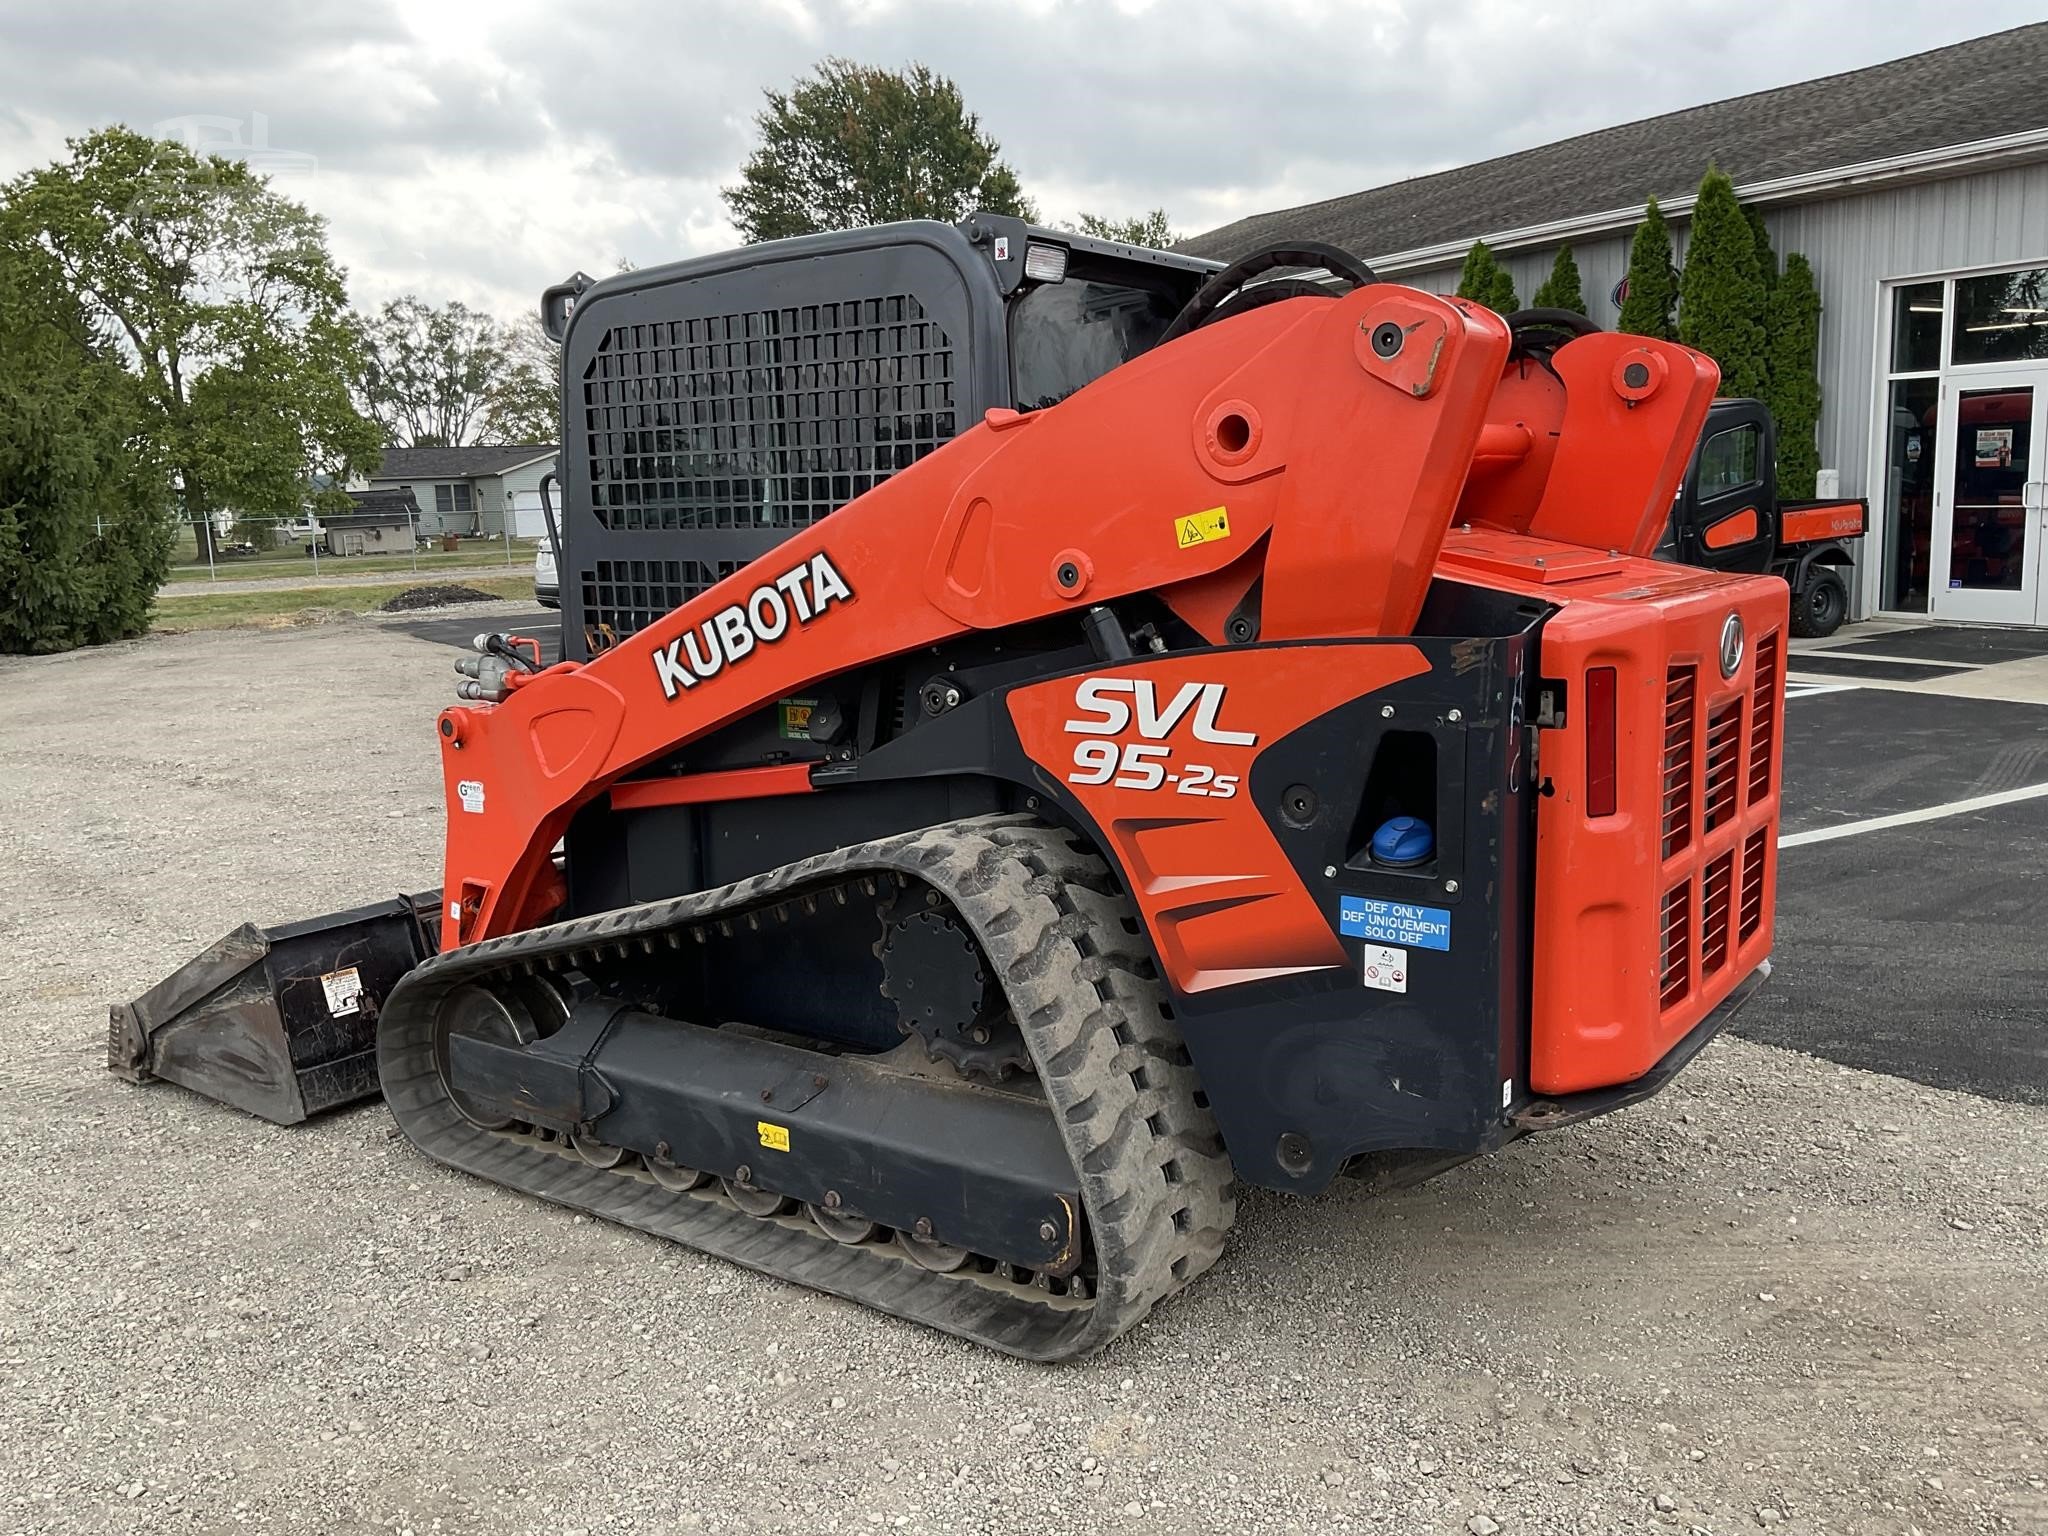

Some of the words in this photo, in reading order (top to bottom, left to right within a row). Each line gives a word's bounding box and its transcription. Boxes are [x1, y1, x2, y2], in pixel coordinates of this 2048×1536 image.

[1831, 519, 1862, 530] Kubota
[652, 553, 852, 698] KUBOTA
[1064, 677, 1257, 746] SVL
[1365, 902, 1388, 913] DEF
[1392, 905, 1424, 920] ONLY
[1342, 910, 1365, 922] DEF
[1368, 914, 1448, 936] UNIQUEMENT
[1364, 925, 1396, 940] SOLO
[1399, 932, 1424, 944] DEF
